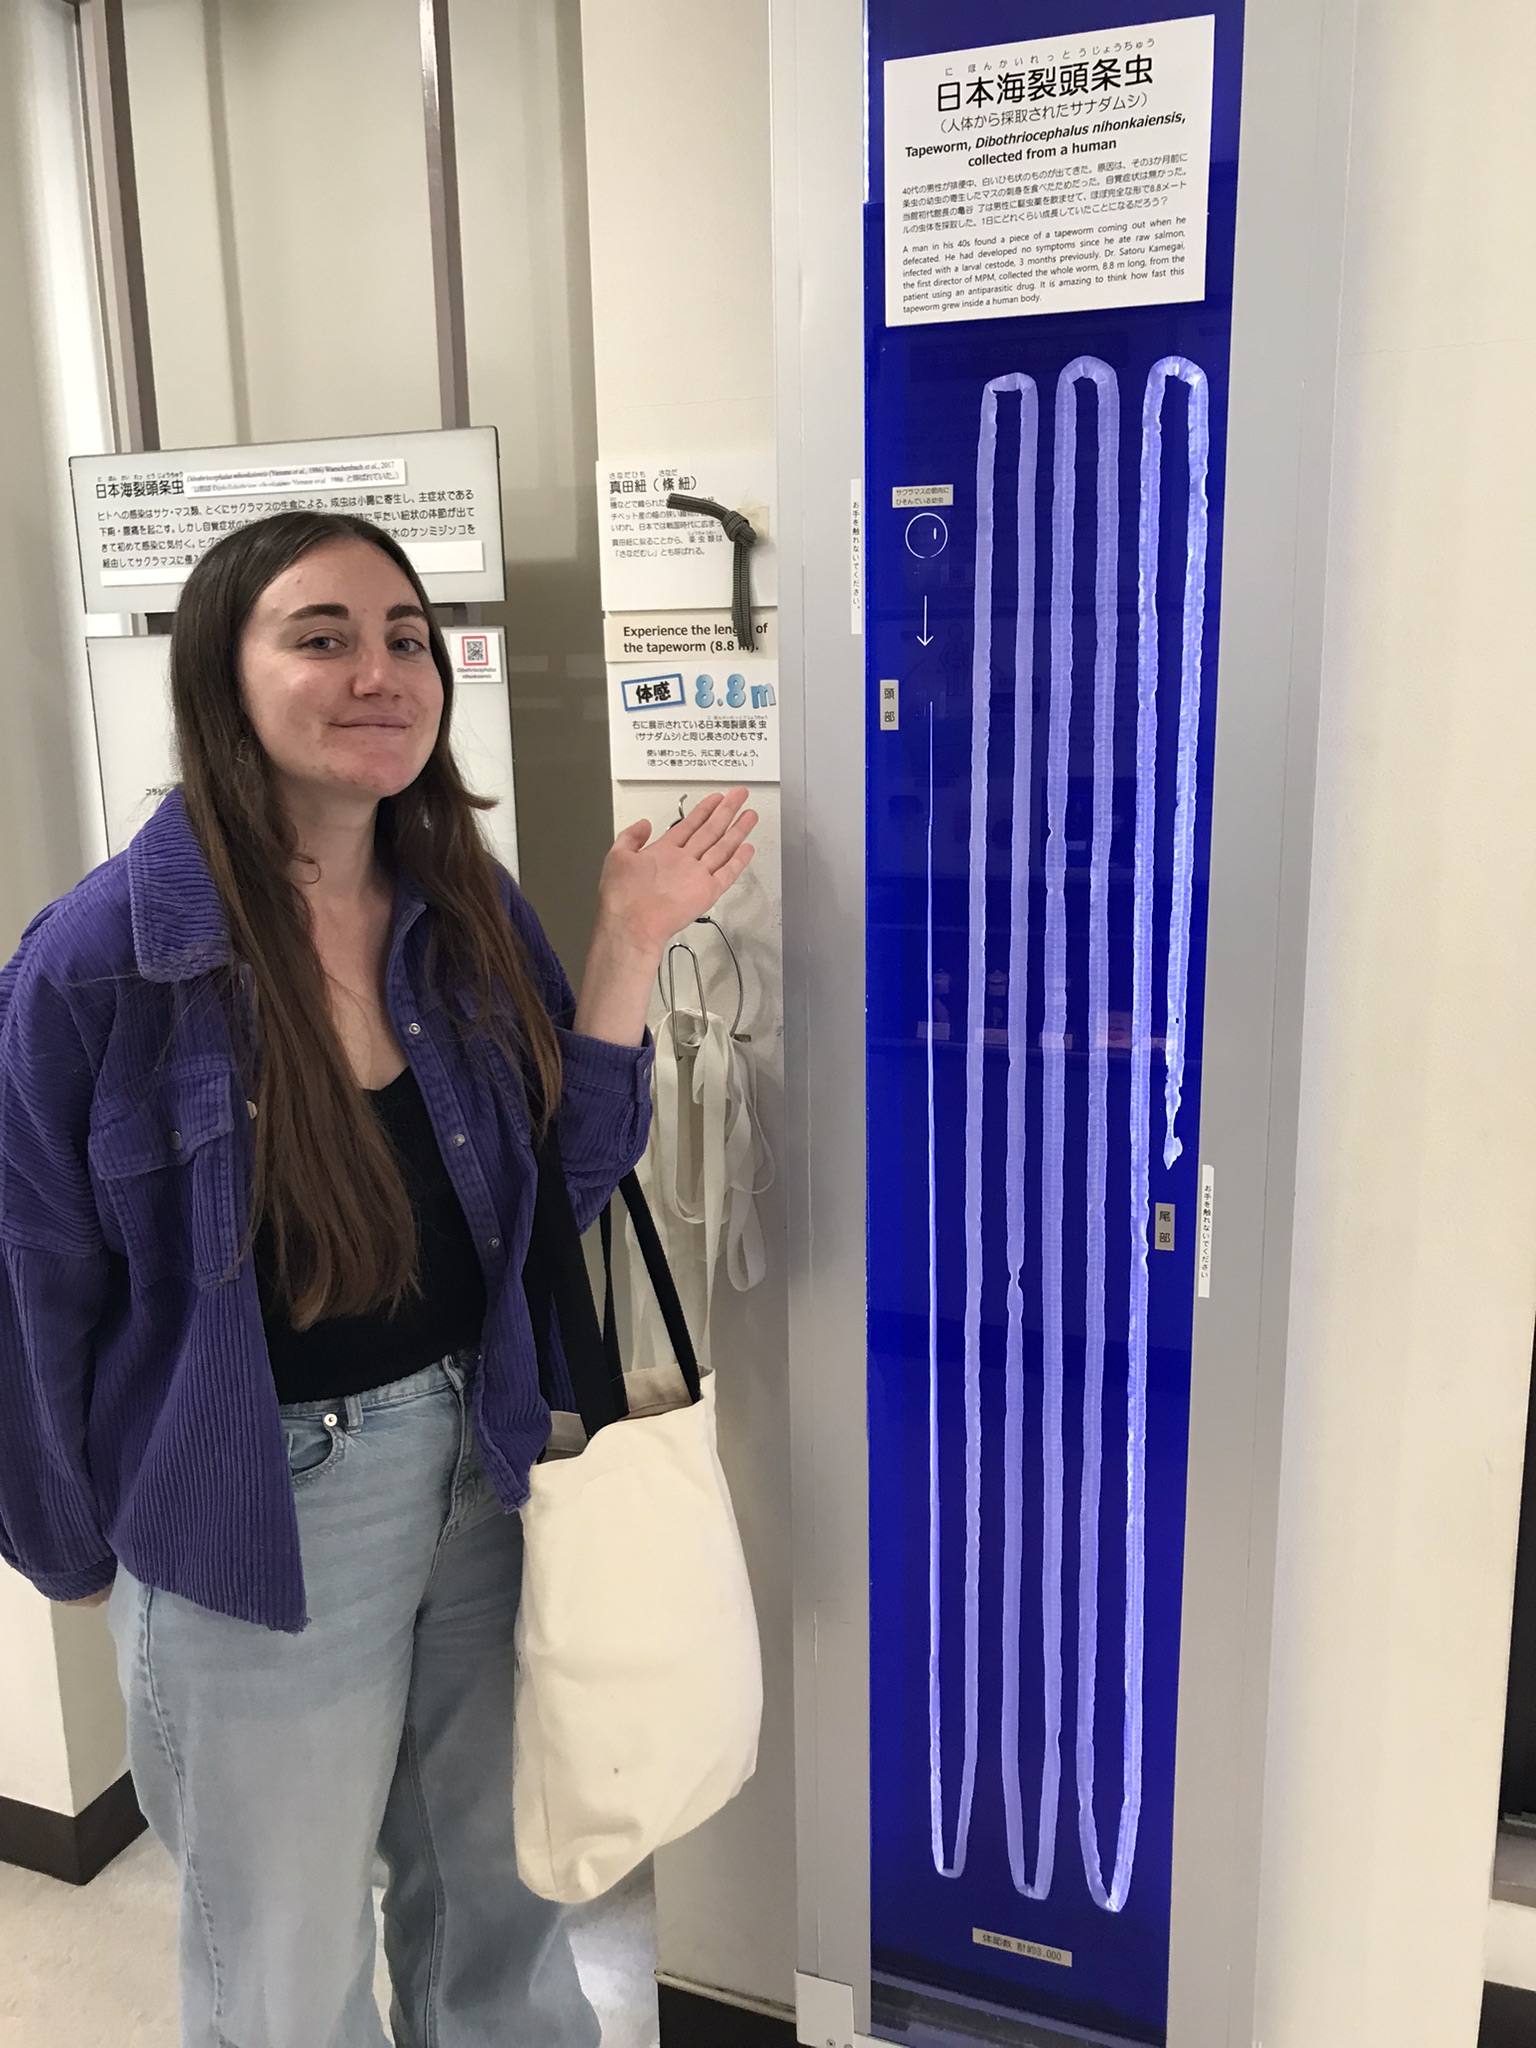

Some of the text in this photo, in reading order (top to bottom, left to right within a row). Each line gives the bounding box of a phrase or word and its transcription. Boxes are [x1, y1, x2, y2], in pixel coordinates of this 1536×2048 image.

[937, 53, 1153, 112] 日本海裂頭条虫
[940, 91, 1147, 133] （人体から採取されたサナダムシ）
[904, 110, 1185, 158] Tapeworm, Dibothriocephalus nihonkaiensis,
[967, 139, 1116, 167] collected from a human
[912, 245, 929, 253] man
[957, 239, 971, 248] 40s
[974, 236, 997, 246] found
[1009, 234, 1030, 245] piece
[1054, 227, 1094, 239] tapeworm
[1097, 223, 1128, 234] coming
[1131, 220, 1146, 230] out
[1149, 218, 1172, 228] when
[959, 250, 974, 260] had
[977, 246, 1018, 259] developed
[1035, 241, 1076, 254] symptoms
[1079, 239, 1100, 248] since
[1118, 235, 1132, 244] ate
[1135, 234, 1151, 242] raw
[902, 266, 933, 278] infected
[934, 265, 952, 274] with
[961, 262, 982, 272] larval
[1027, 255, 1057, 265] months
[1119, 247, 1146, 257] Satoru
[916, 279, 932, 288] first
[933, 277, 963, 287] director
[998, 269, 1033, 281] collected
[1049, 265, 1074, 275] whole
[1149, 256, 1170, 266] from
[1171, 254, 1186, 264] the
[902, 292, 929, 303] patient
[931, 290, 952, 300] using
[967, 284, 1013, 296] antiparasitic
[1058, 277, 1092, 287] amazing
[1107, 272, 1127, 283] think
[1130, 271, 1149, 280] how
[1151, 269, 1167, 278] fast
[1169, 267, 1185, 276] this
[902, 303, 940, 315] tapeworm
[941, 302, 961, 312] grew
[961, 298, 984, 308] inside
[992, 296, 1019, 305] human
[95, 479, 185, 499] 日本海裂頭条虫
[609, 471, 646, 480] さなだひも
[623, 625, 688, 640] Experience
[691, 624, 711, 635] the
[755, 622, 768, 634] of
[623, 642, 645, 654] the
[647, 641, 706, 656] tapeworm
[710, 640, 735, 654] (8.8
[635, 681, 671, 705] 体感
[884, 688, 895, 723] 頭部
[1158, 1211, 1171, 1243] 尾部
